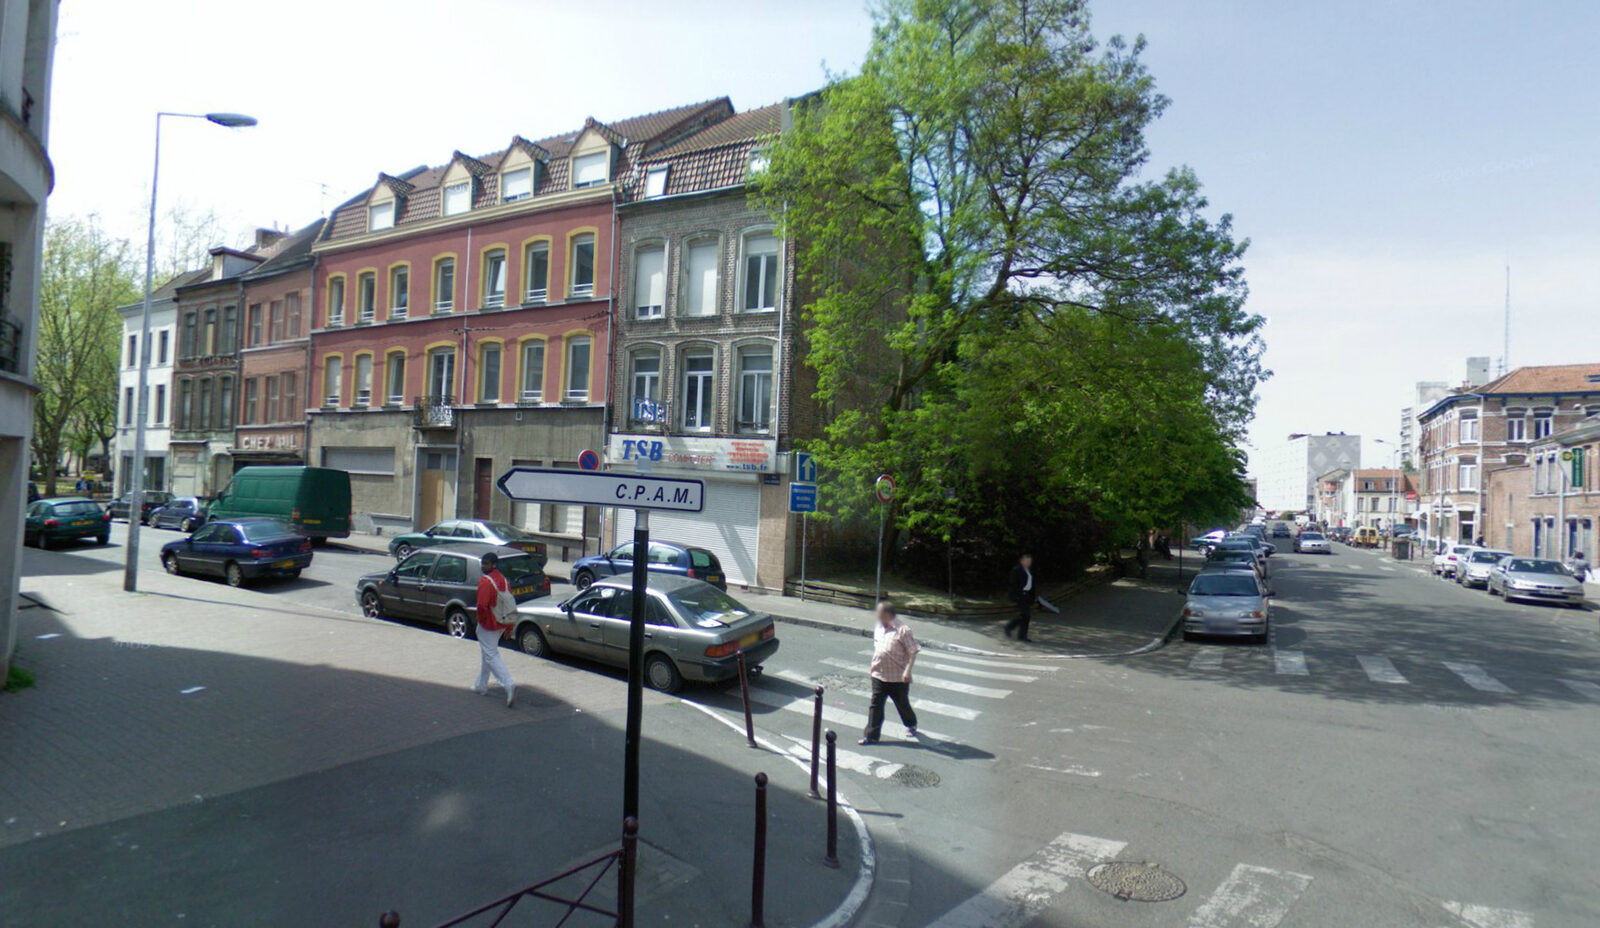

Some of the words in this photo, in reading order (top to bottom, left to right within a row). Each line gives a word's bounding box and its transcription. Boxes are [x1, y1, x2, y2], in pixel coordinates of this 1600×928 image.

[243, 436, 271, 450] CHEZ
[622, 439, 663, 462] TSB
[615, 483, 693, 505] C.P.A.M.
